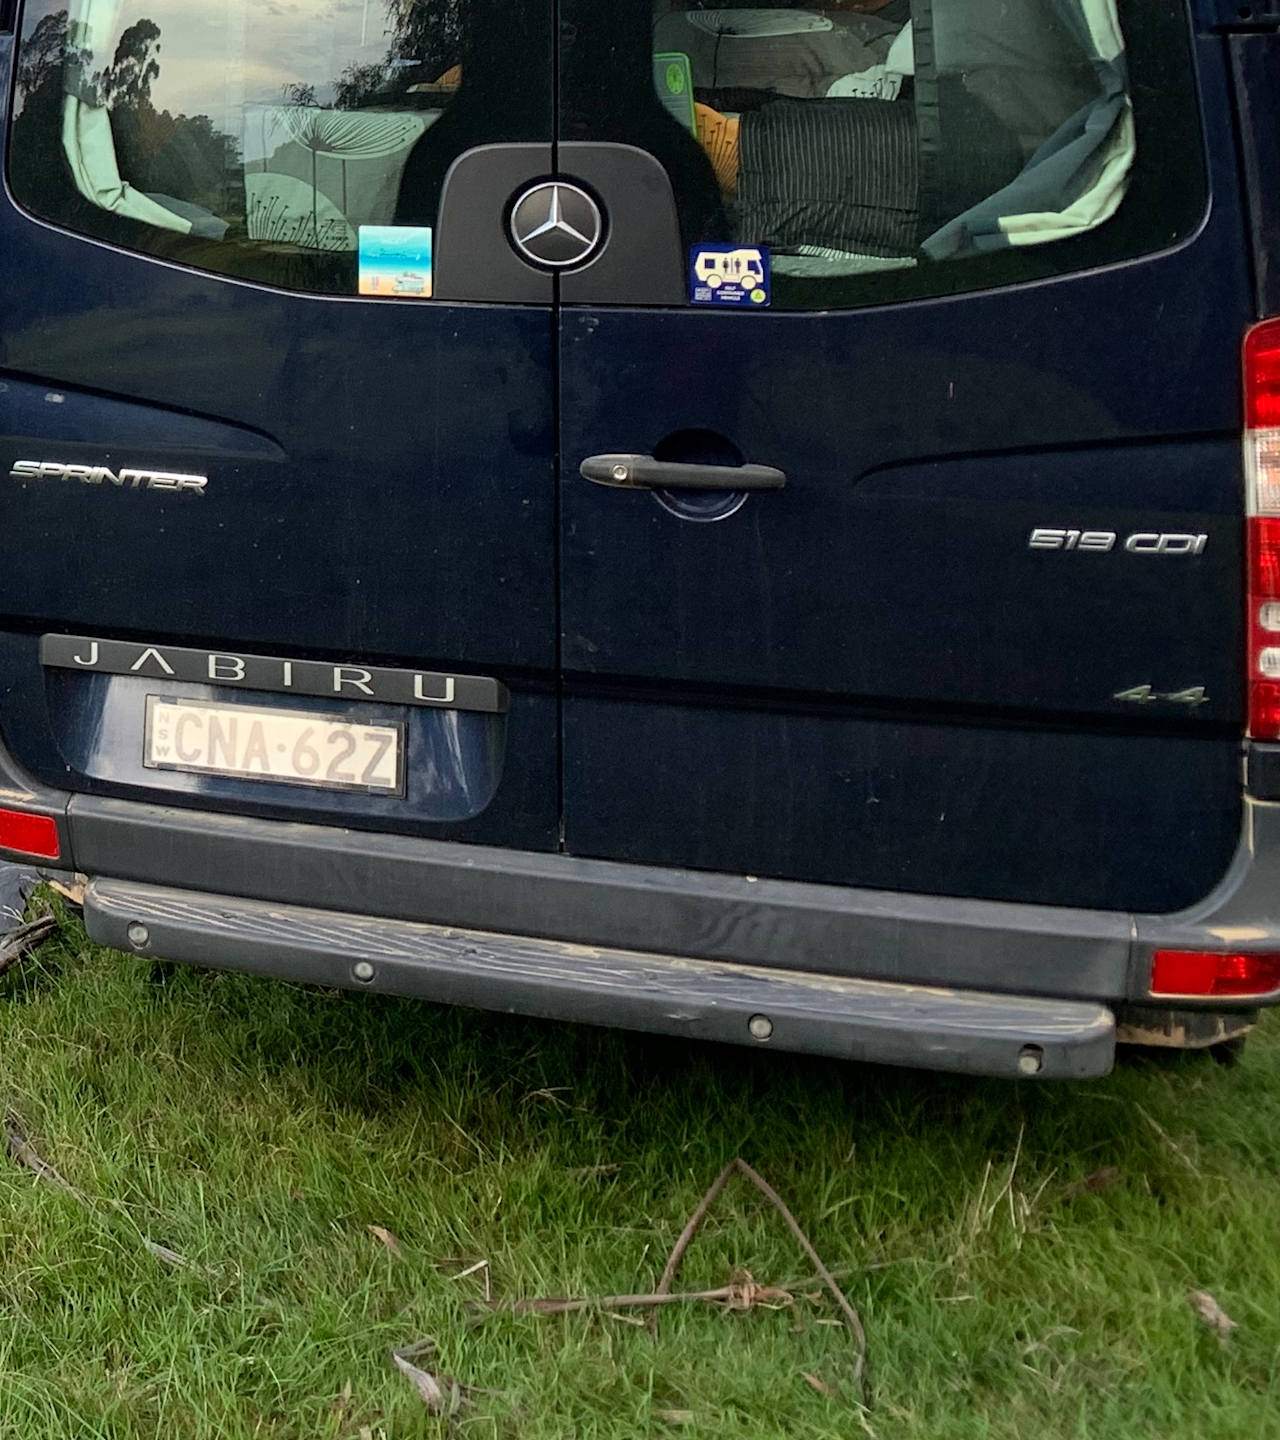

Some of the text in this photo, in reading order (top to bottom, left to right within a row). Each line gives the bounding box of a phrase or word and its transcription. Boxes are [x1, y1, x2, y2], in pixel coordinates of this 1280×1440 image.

[9, 460, 209, 495] SPRINTER
[1028, 528, 1208, 555] 519 CDI
[73, 641, 455, 703] JABIRU
